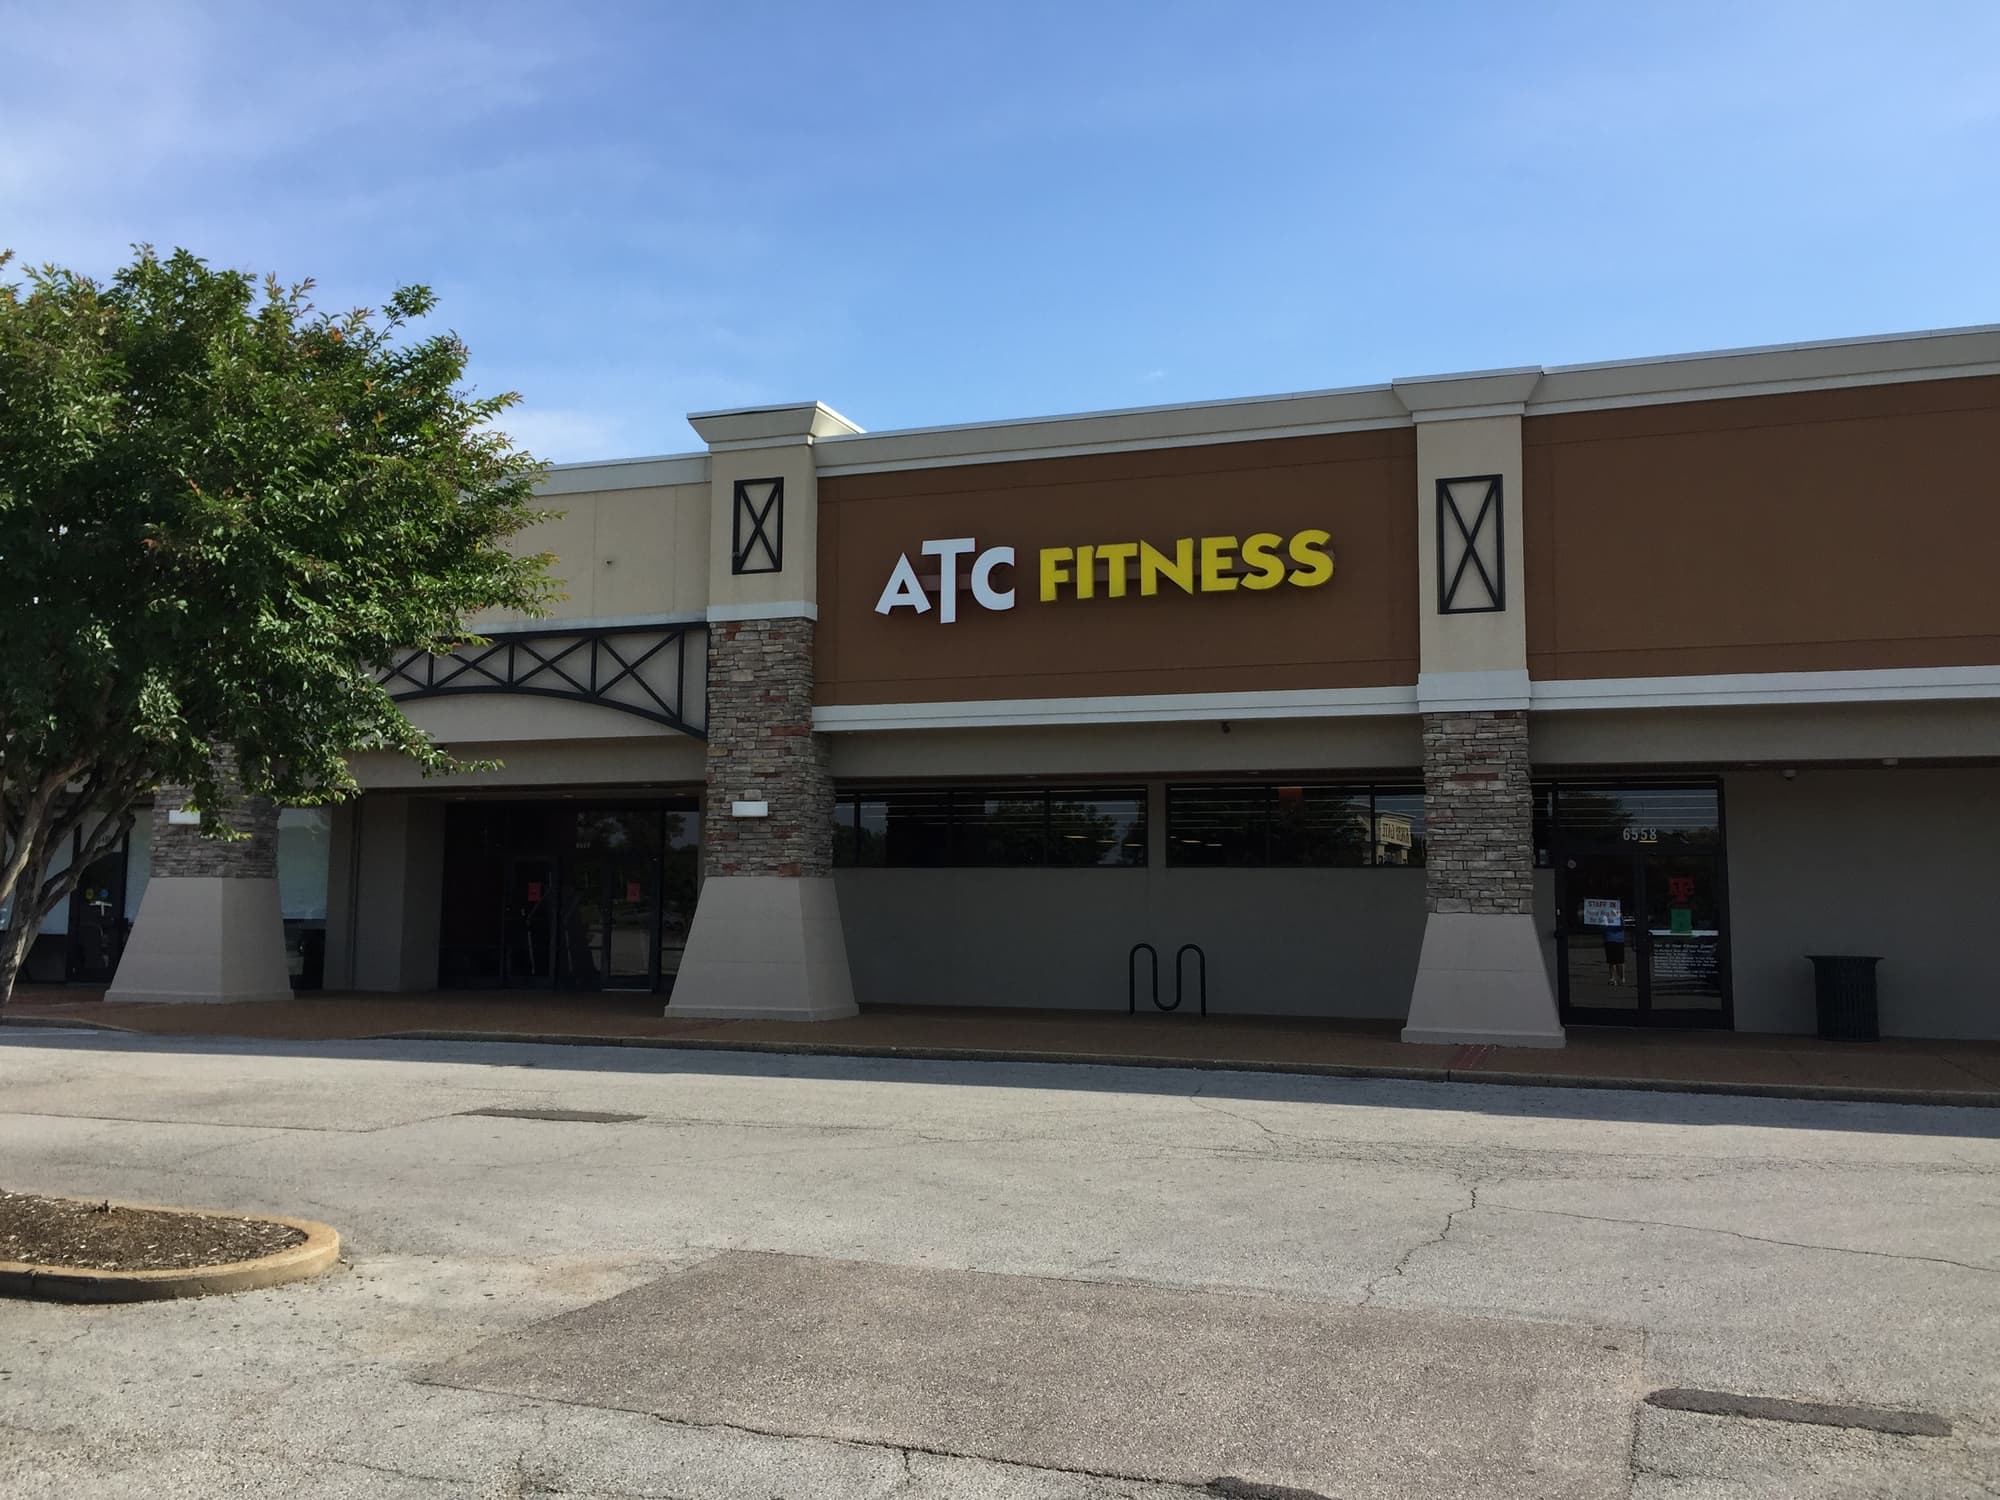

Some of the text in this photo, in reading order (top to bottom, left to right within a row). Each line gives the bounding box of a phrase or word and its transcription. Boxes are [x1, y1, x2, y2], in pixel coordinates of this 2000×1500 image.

[874, 529, 1335, 624] ATC FITNESS
[1622, 827, 1657, 841] 6558
